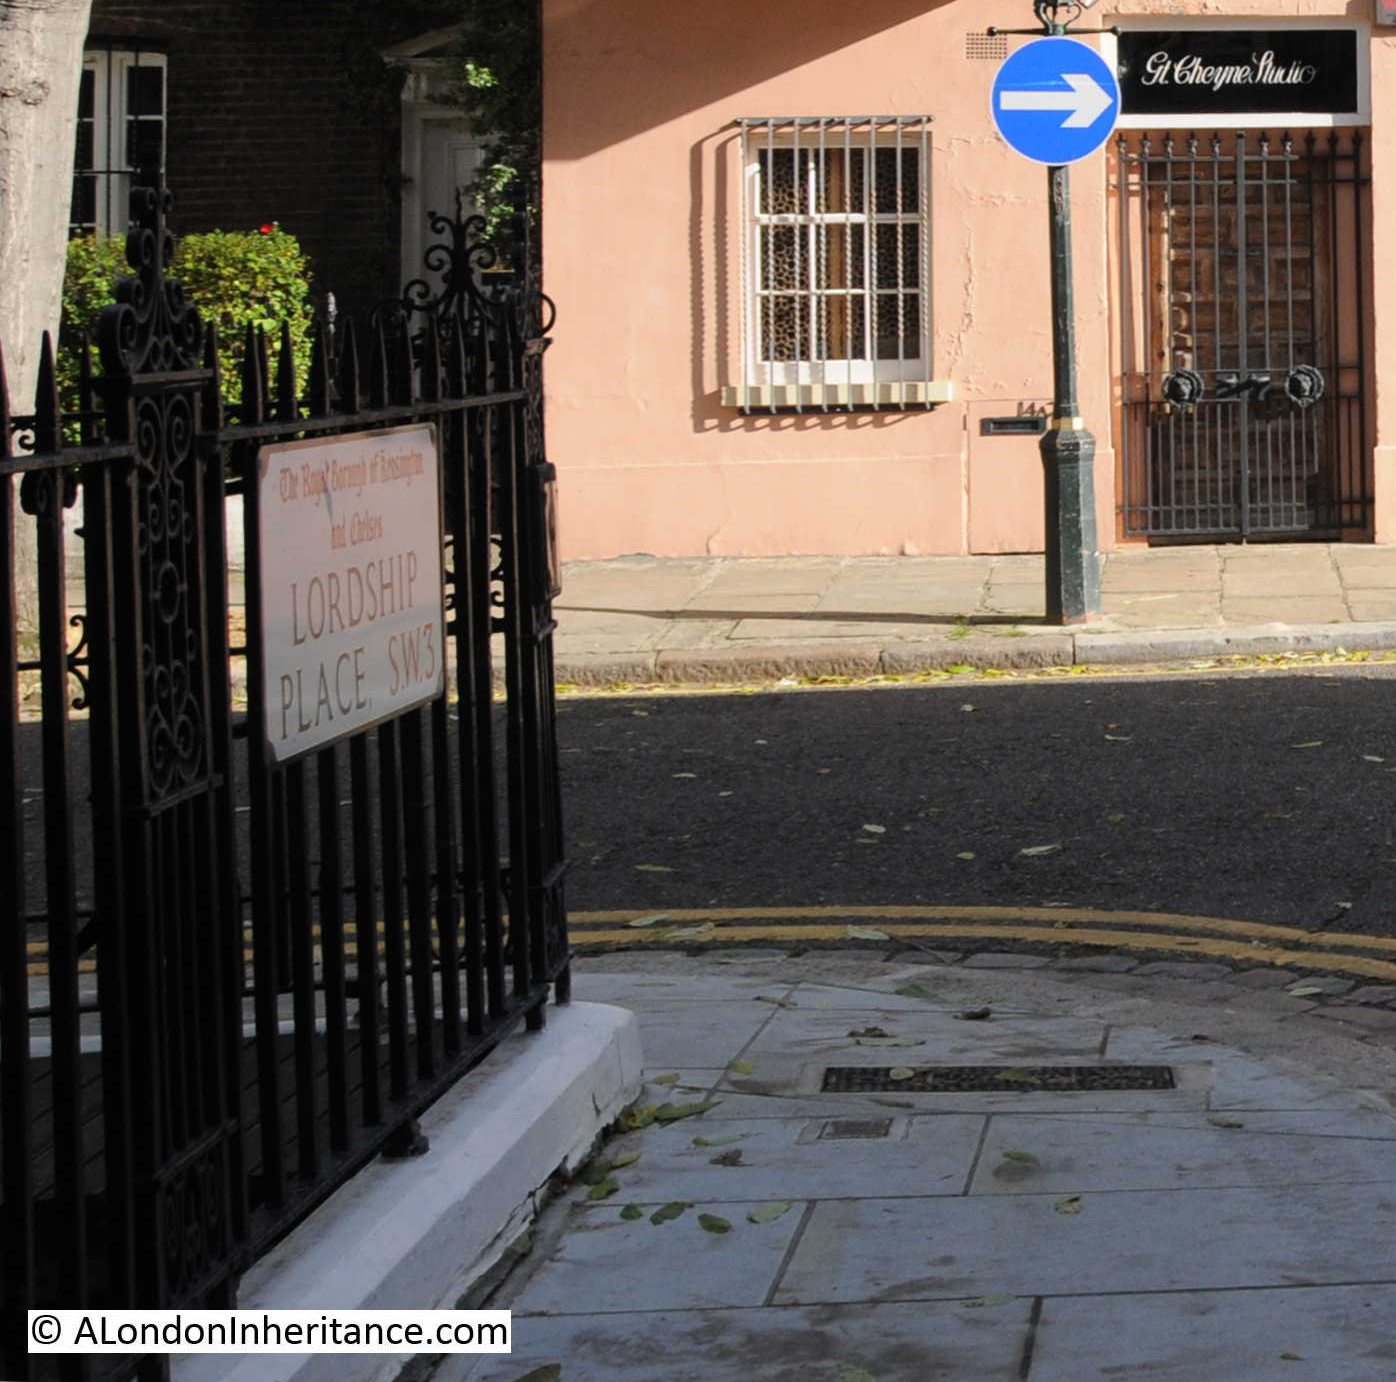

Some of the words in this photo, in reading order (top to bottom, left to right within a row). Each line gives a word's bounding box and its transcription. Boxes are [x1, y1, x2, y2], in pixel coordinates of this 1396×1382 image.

[1174, 54, 1250, 91] Cheyne
[1248, 50, 1316, 86] Studio
[291, 550, 417, 646] LORDSHIP
